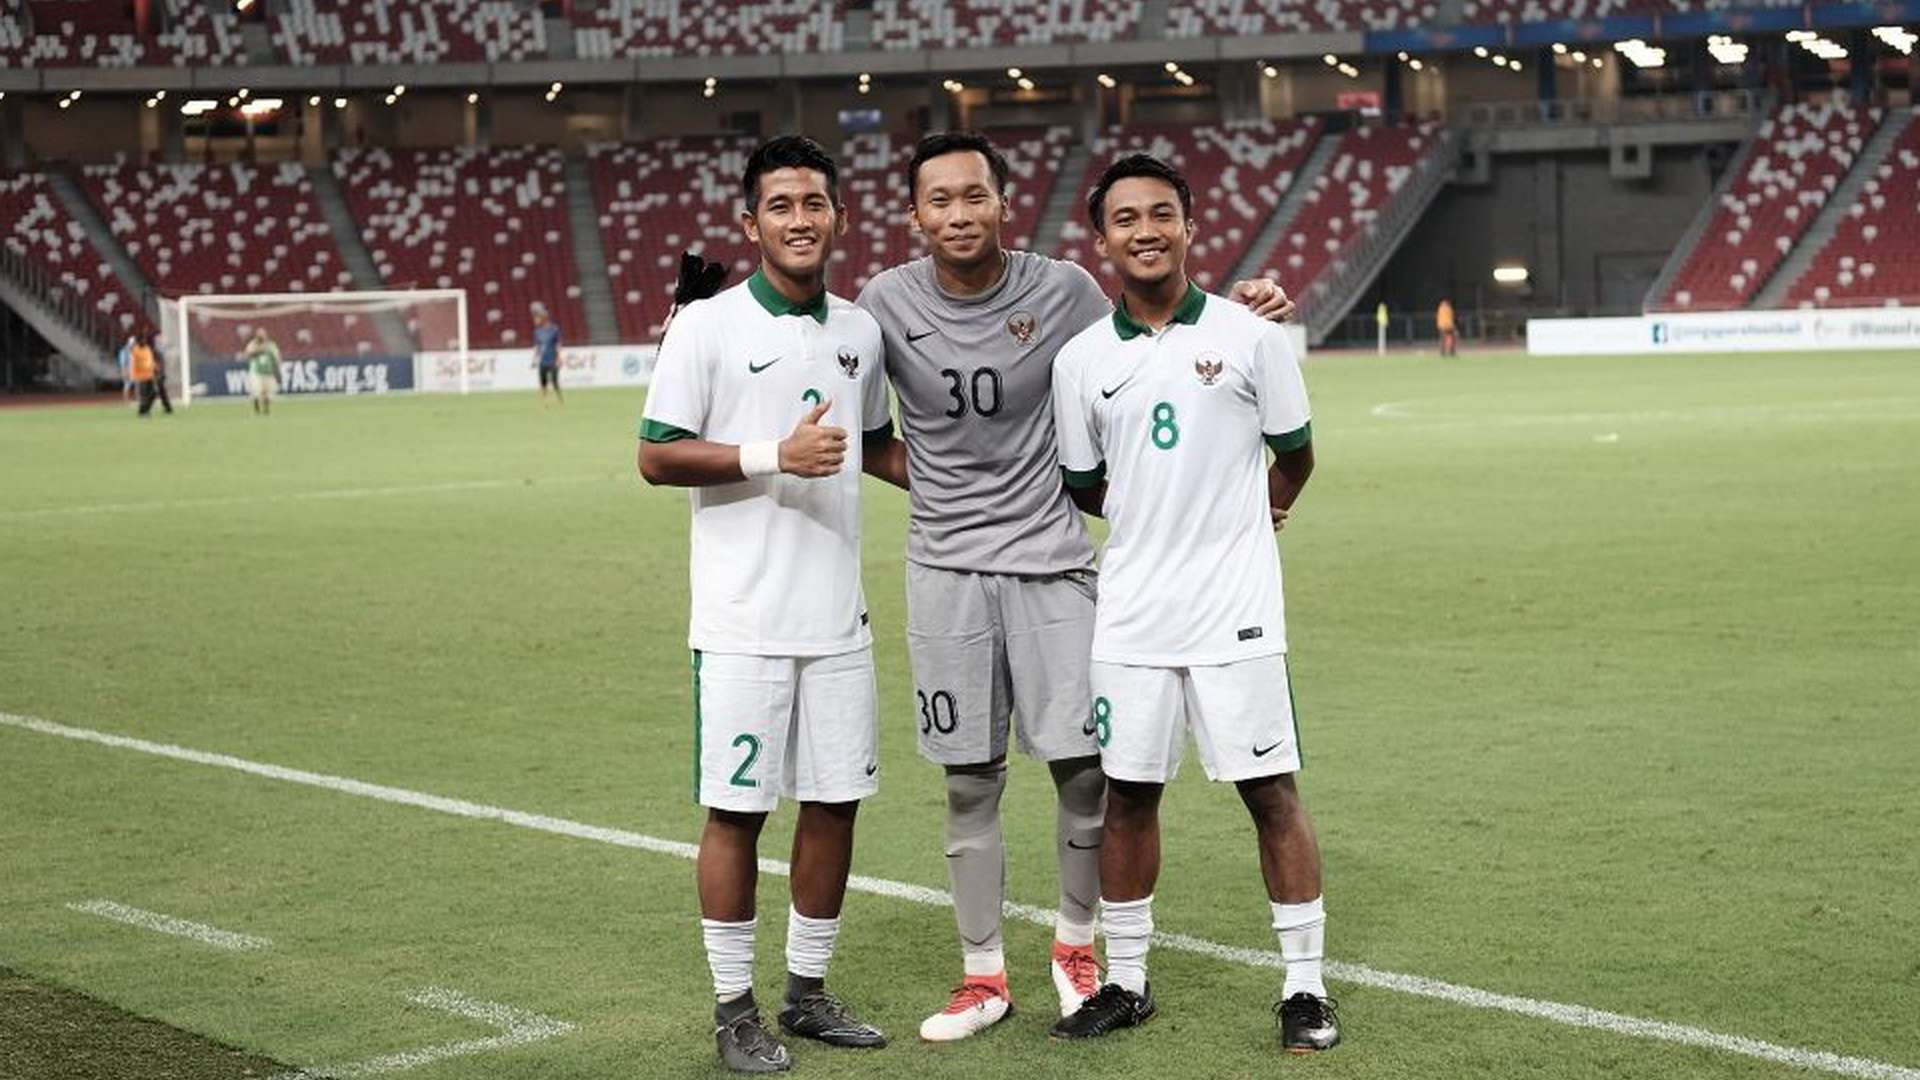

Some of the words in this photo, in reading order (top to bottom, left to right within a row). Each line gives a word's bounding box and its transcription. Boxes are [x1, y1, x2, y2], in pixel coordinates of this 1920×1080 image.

[941, 366, 1004, 419] 30
[1152, 401, 1179, 450] 8
[917, 689, 960, 735] 30
[1095, 696, 1112, 748] 8
[730, 733, 762, 788] 2
